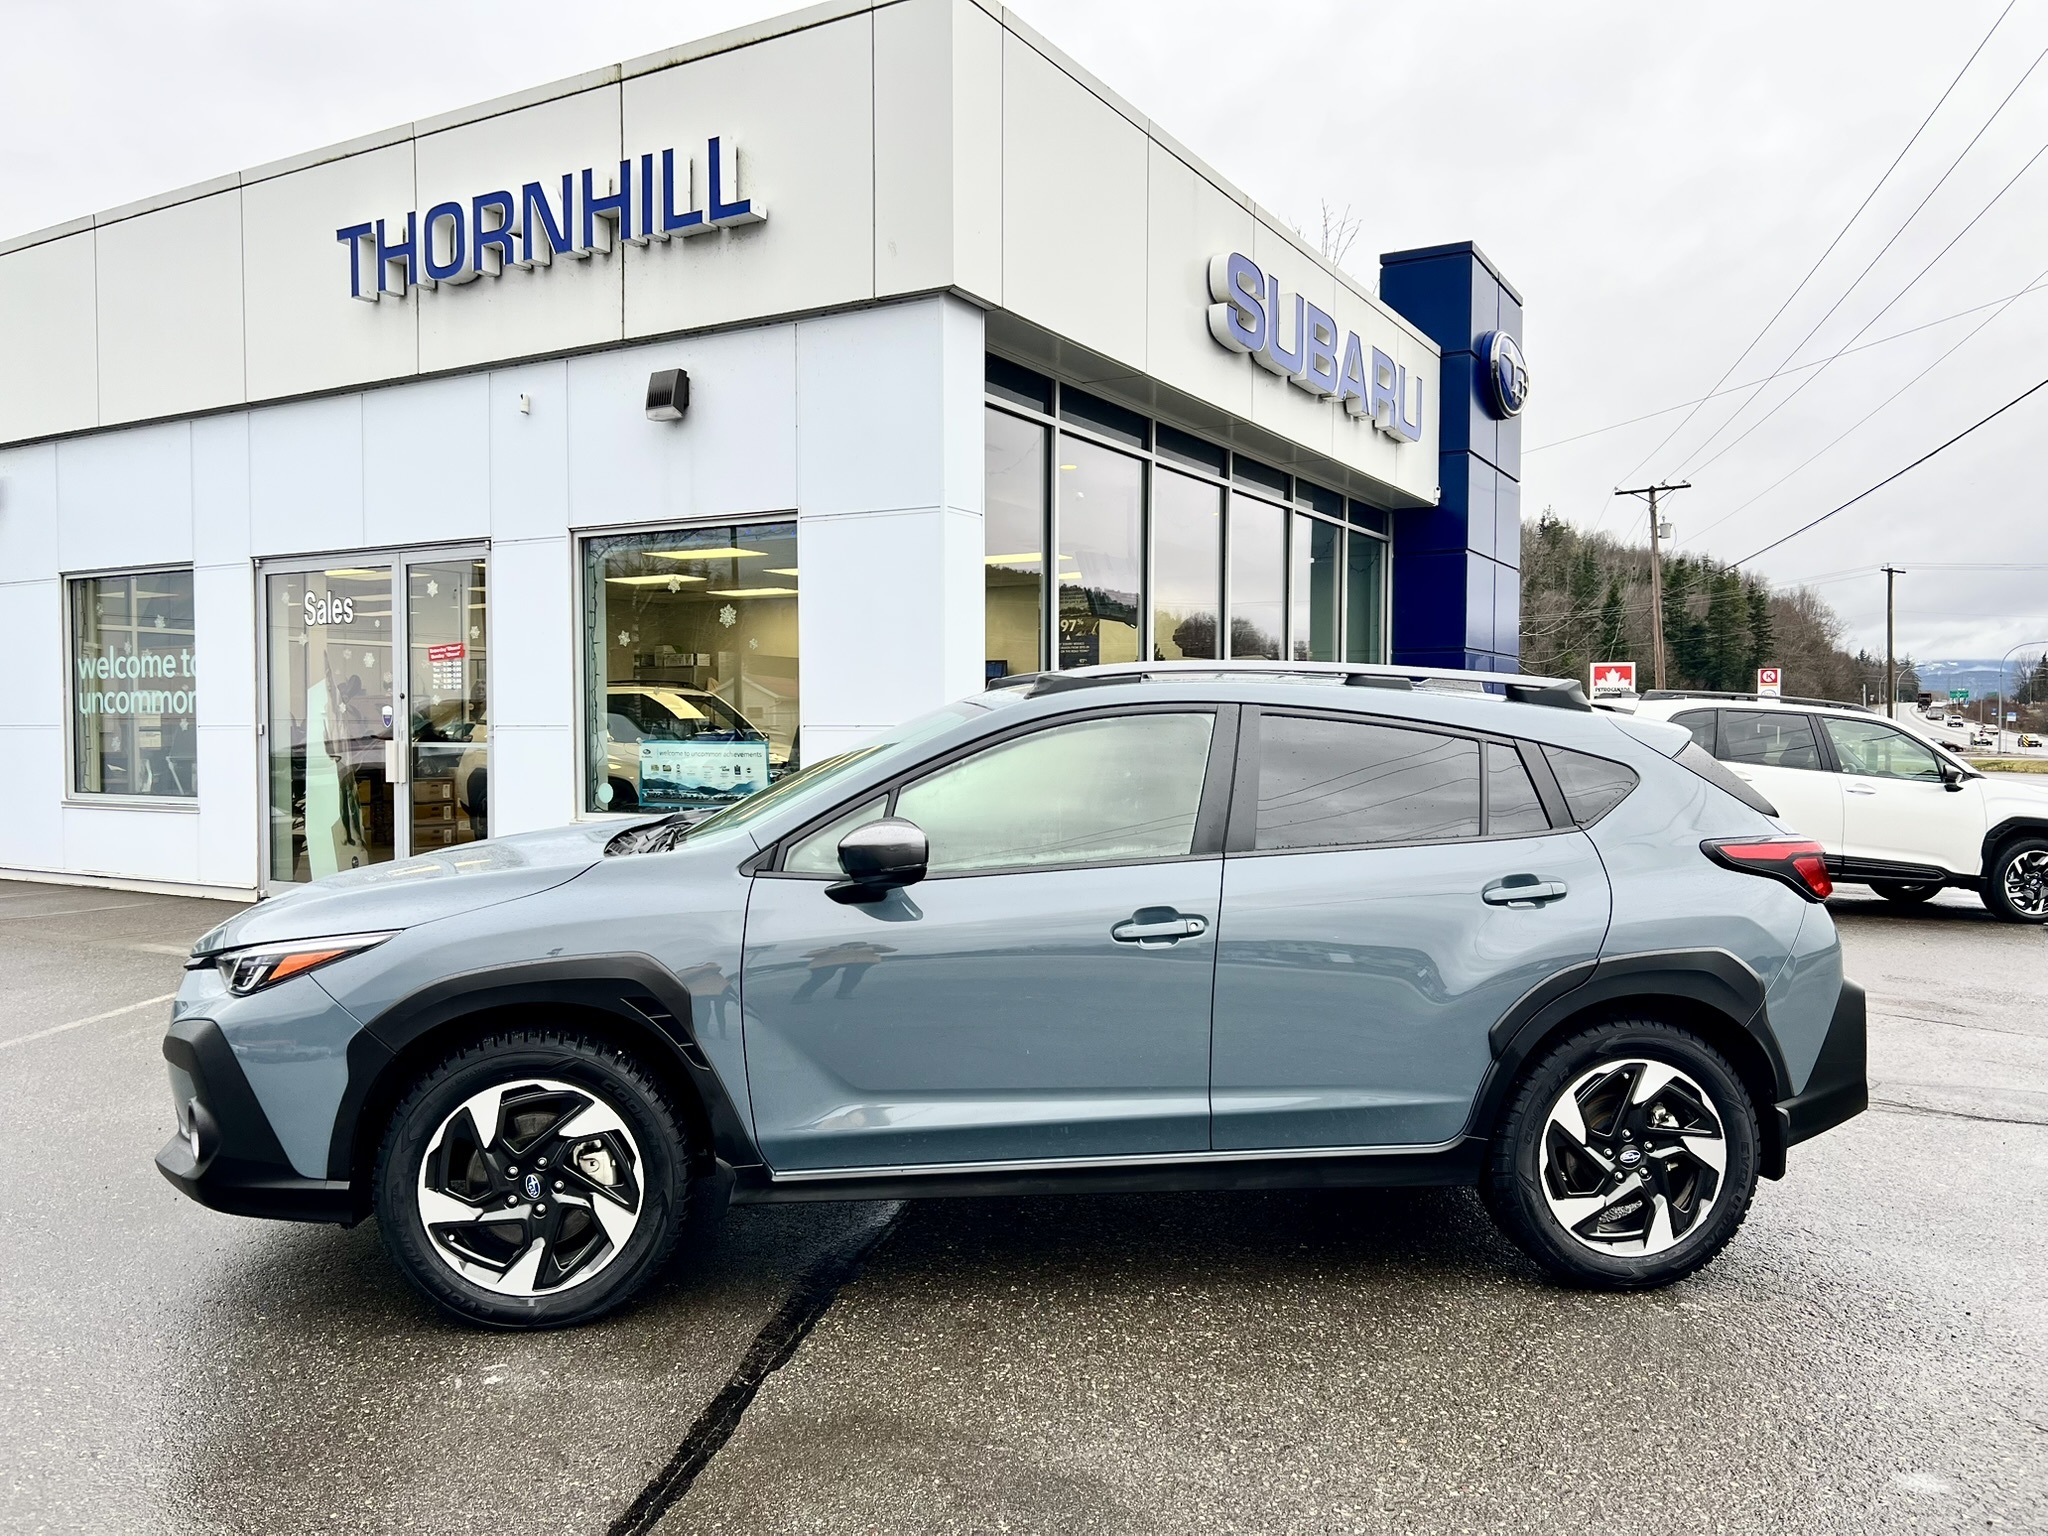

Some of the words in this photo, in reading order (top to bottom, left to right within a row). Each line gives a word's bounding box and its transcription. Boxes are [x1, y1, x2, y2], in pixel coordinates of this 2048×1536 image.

[336, 136, 753, 301] THORNHILL
[1226, 252, 1423, 443] SUBARU
[304, 591, 354, 626] Sales
[78, 645, 176, 679] welcome
